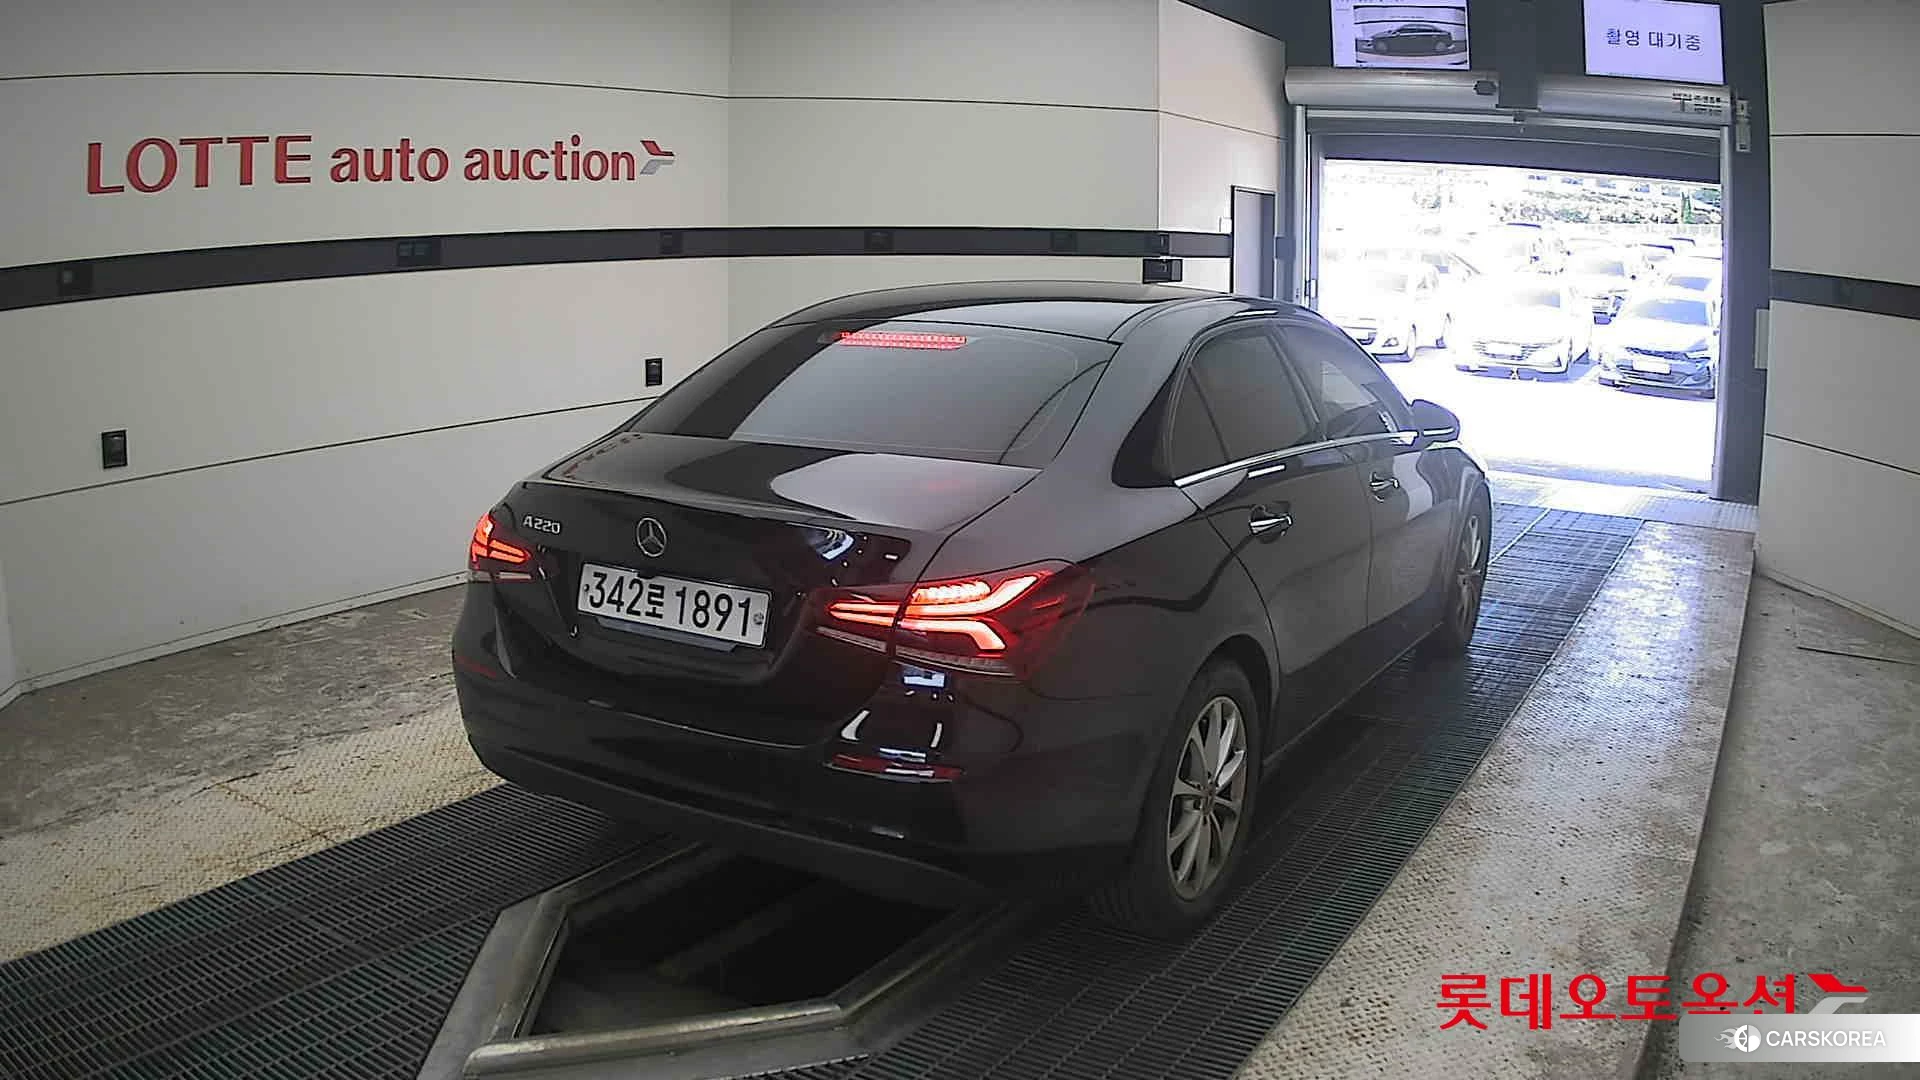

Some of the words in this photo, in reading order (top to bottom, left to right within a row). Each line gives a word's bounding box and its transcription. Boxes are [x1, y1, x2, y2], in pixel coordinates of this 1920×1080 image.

[1648, 32, 1701, 51] 대기중
[86, 134, 312, 195] LOTTE
[329, 137, 449, 183] auto
[463, 134, 636, 182] auction
[522, 515, 561, 535] A220
[588, 571, 665, 620] 342로
[675, 585, 752, 637] 1891
